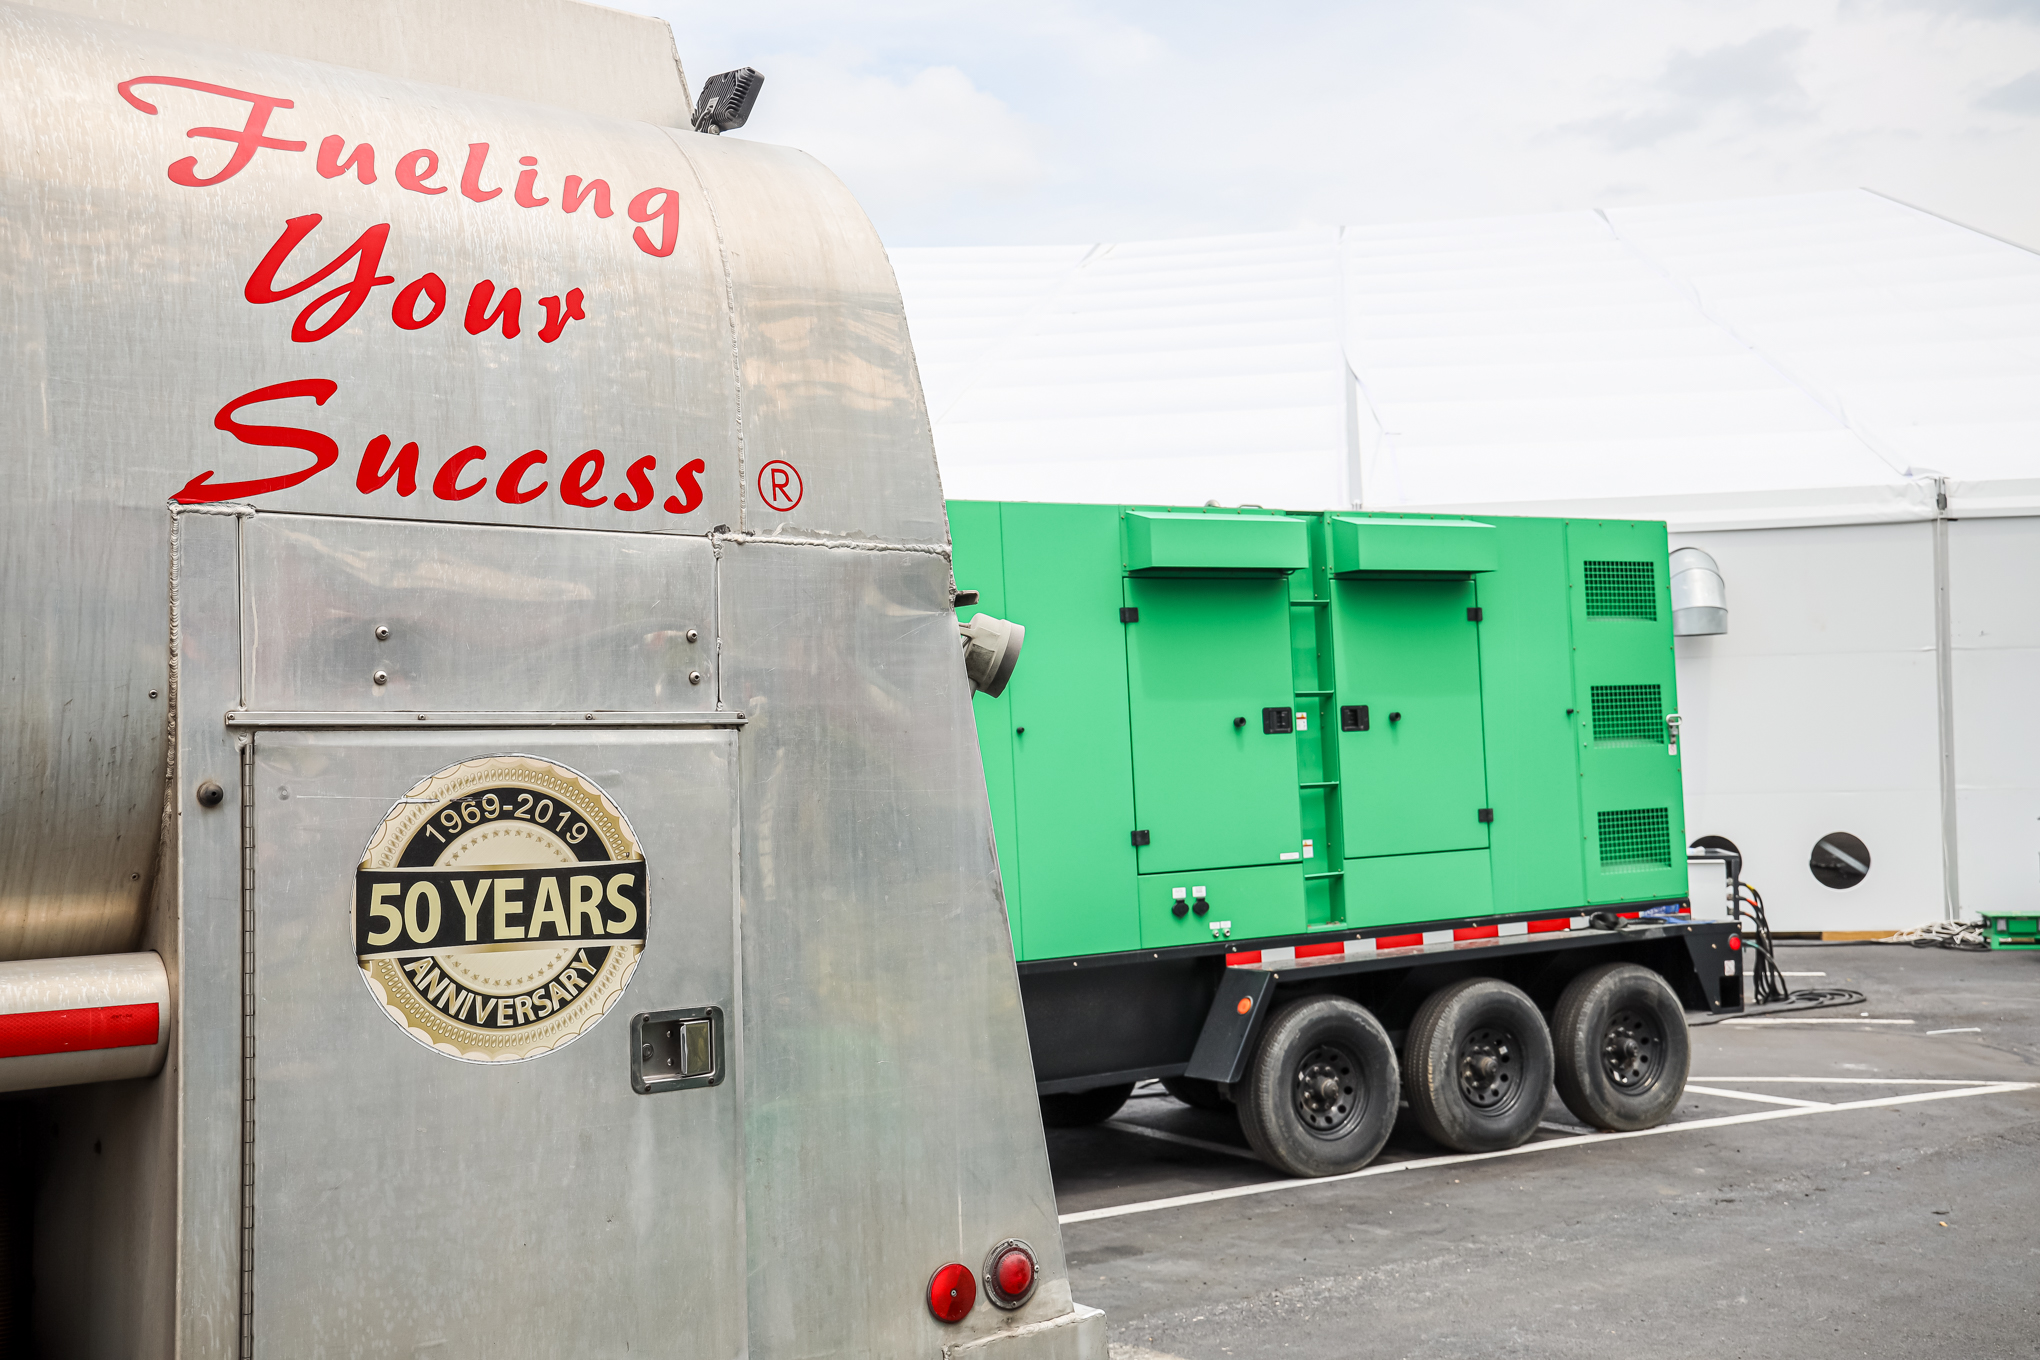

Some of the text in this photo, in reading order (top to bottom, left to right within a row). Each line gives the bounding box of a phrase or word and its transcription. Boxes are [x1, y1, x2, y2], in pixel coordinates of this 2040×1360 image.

[117, 75, 680, 258] Fueling
[244, 212, 586, 343] Your
[168, 377, 706, 514] Success
[425, 792, 589, 845] 1969-2019
[366, 872, 638, 946] 50 YEARS
[403, 948, 598, 1027] ANNIVERSARY
